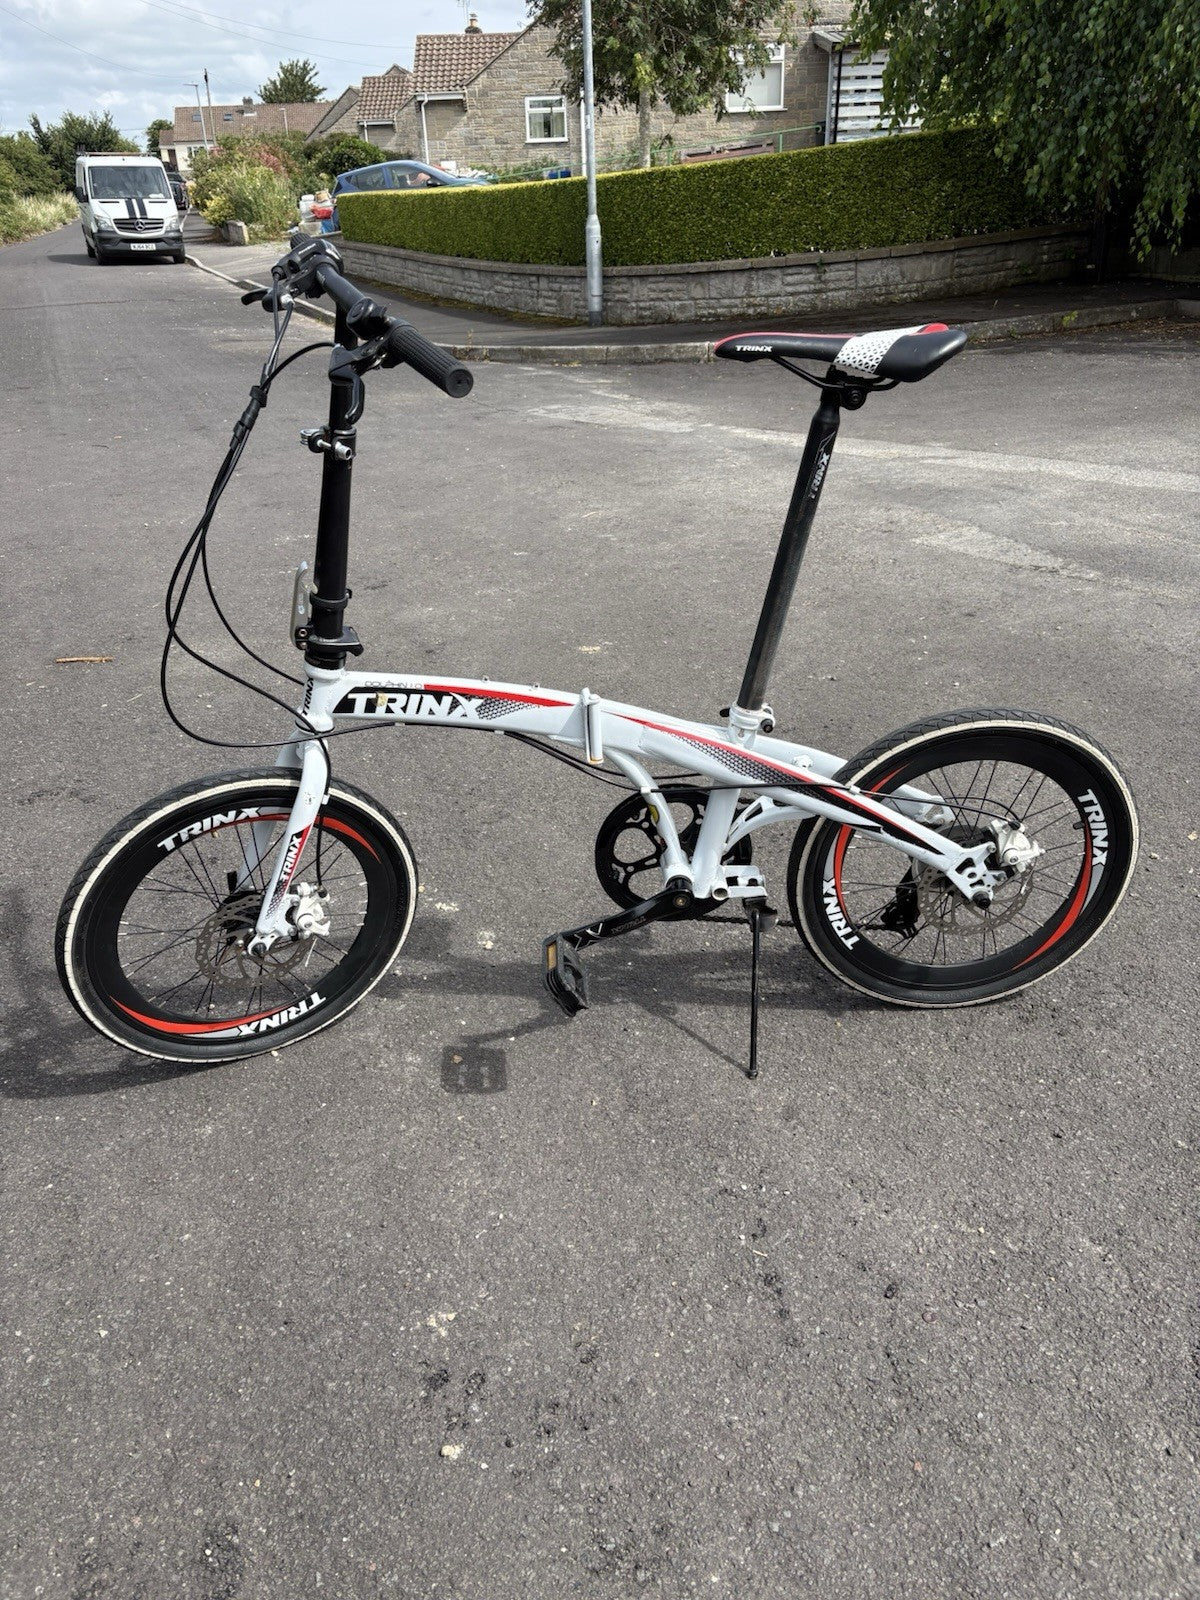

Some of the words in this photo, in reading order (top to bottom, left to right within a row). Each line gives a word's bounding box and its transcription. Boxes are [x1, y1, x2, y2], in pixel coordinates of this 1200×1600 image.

[735, 345, 772, 353] TRINX
[808, 452, 830, 499] TRINX
[301, 677, 314, 716] TRINX
[347, 692, 484, 718] TRINX
[157, 807, 262, 852] TRINX
[1078, 789, 1109, 867] TRINX
[280, 835, 303, 882] TRINX
[822, 878, 861, 950] TRINX
[237, 992, 326, 1037] TRINX
